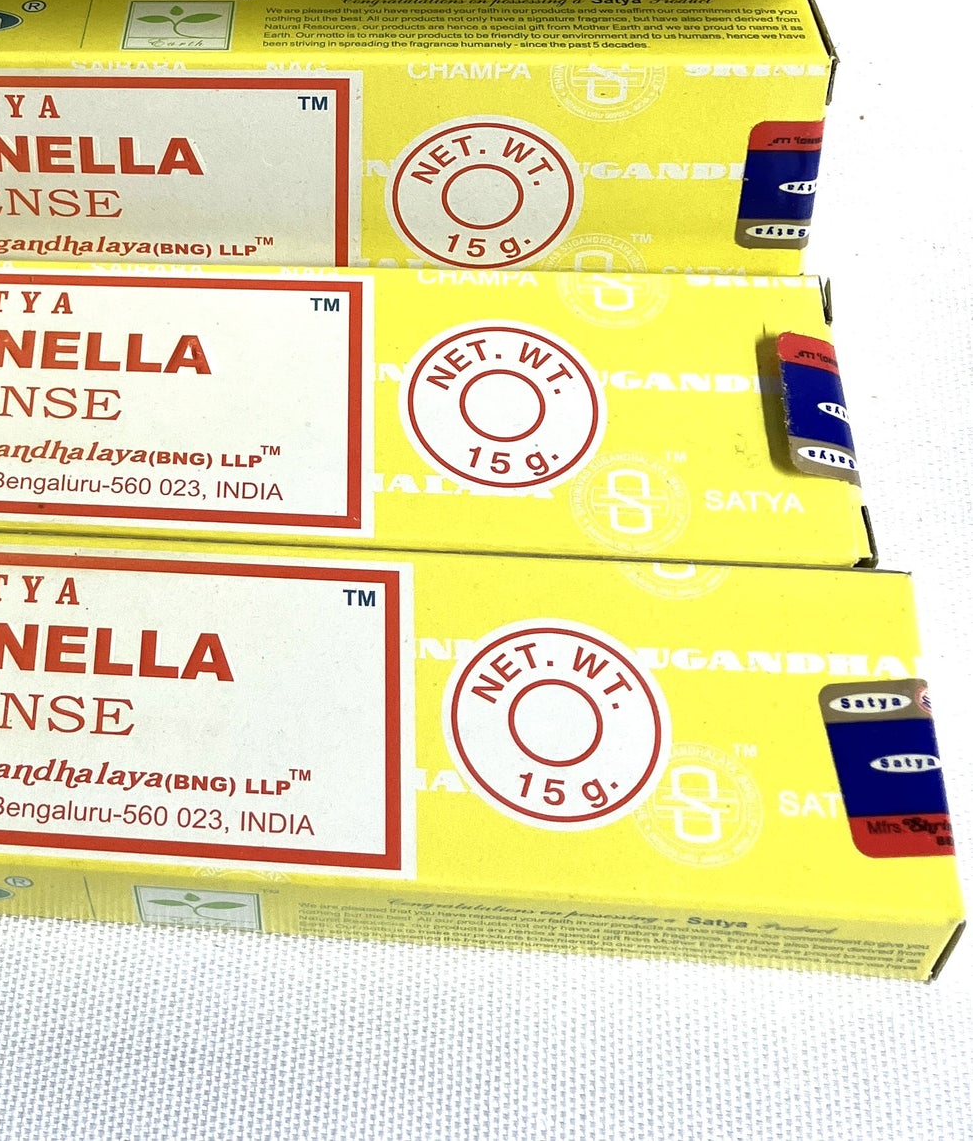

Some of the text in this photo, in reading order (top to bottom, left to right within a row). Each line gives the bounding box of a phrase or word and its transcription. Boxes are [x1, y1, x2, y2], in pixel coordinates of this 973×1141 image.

[410, 41, 458, 49] fragrance
[408, 62, 531, 80] CHAMPA
[298, 96, 328, 110] TM
[411, 136, 552, 186] NET. WT.
[220, 244, 257, 256] LLP
[255, 236, 274, 245] TM
[447, 233, 531, 259] 15 g.
[311, 298, 340, 312] TM
[427, 339, 573, 394] NET. WT.
[221, 454, 262, 467] LLP
[261, 445, 280, 456] TM
[469, 446, 559, 476] 15 g.
[159, 479, 206, 500] 023,
[217, 481, 283, 501] INDIA
[705, 491, 804, 513] SATYA
[343, 590, 376, 607] TM
[472, 642, 633, 710] NET. WT.
[841, 697, 901, 709] Satya
[880, 758, 936, 769] Satya
[246, 779, 291, 796] LLP
[289, 769, 311, 781] TM
[519, 772, 619, 808] 15 g.
[177, 807, 229, 833] 023,
[240, 811, 315, 836] INDIA
[687, 916, 749, 928] Satya
